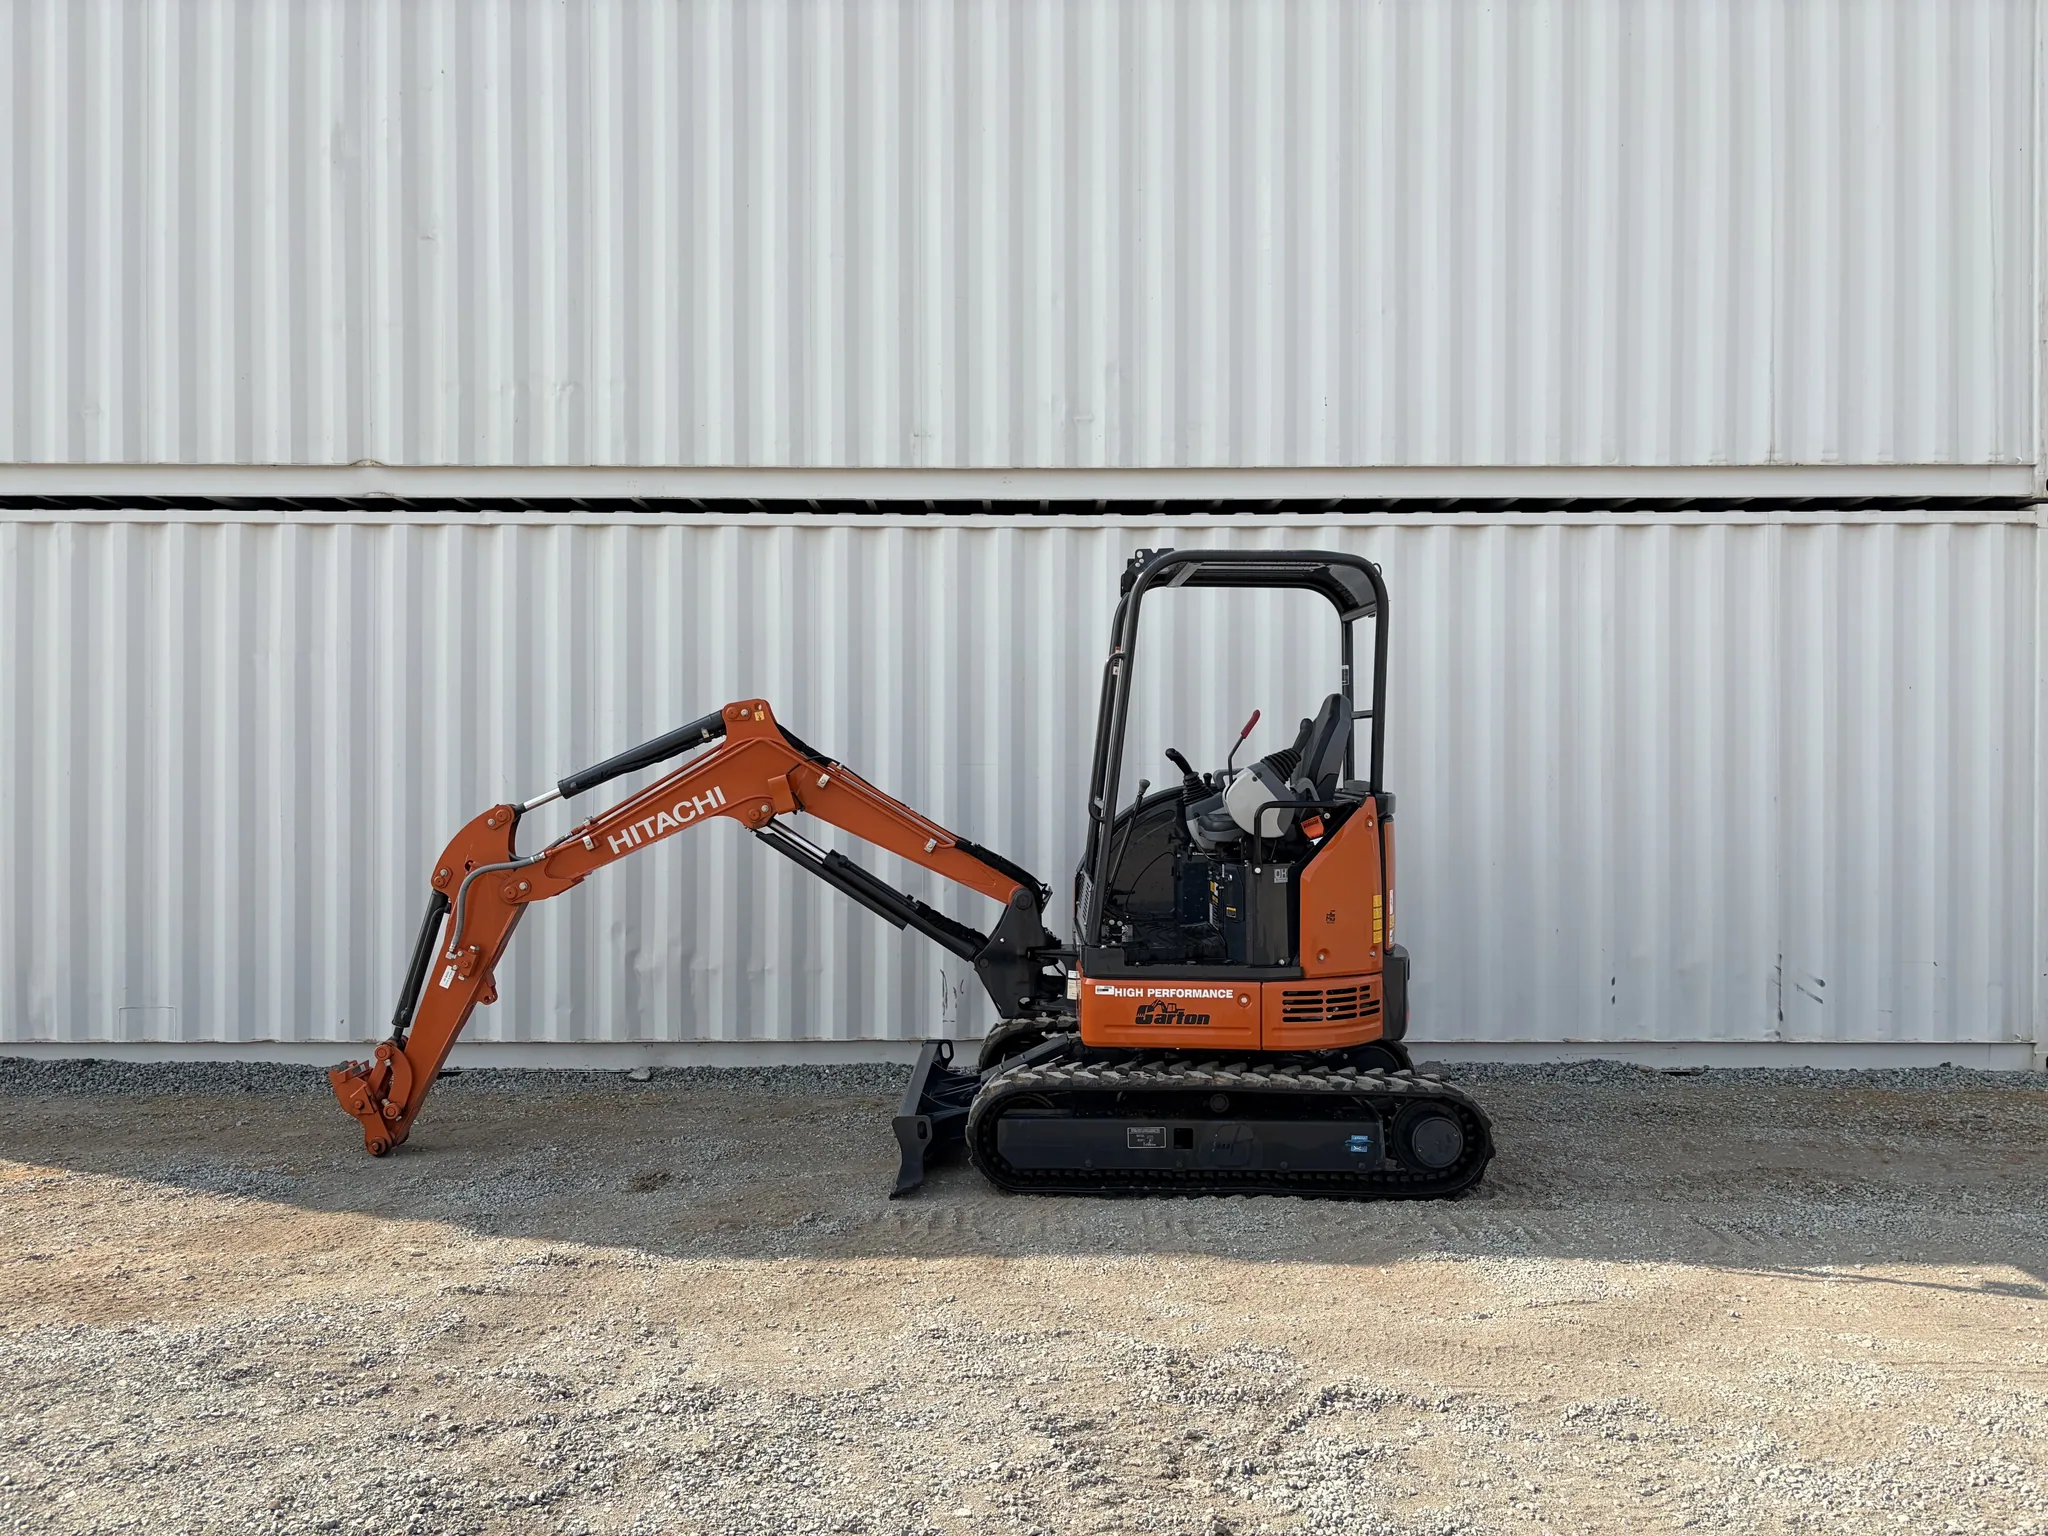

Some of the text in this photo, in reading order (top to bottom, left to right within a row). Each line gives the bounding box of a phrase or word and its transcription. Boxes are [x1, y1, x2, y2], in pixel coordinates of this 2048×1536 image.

[607, 786, 727, 854] HITACHI
[1114, 988, 1143, 997] HIGH
[1147, 988, 1234, 999] PERFORMANCE
[1135, 1002, 1210, 1025] Garton
